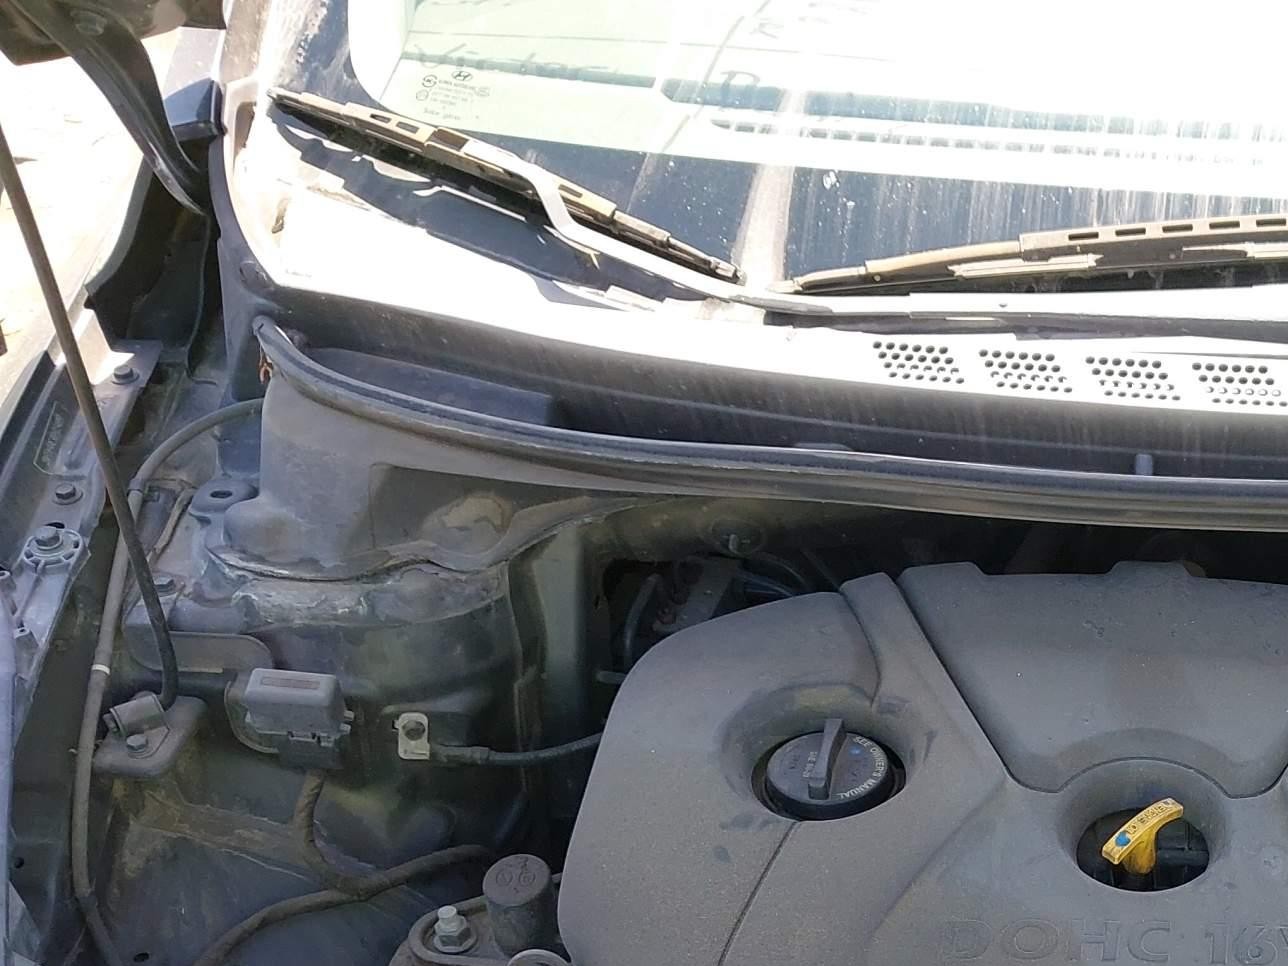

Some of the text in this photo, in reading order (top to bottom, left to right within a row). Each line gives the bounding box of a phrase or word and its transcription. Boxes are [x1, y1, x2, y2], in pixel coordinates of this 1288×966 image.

[853, 736, 872, 747] SEE
[837, 779, 878, 799] MANUAL
[944, 919, 1172, 963] DOHC
